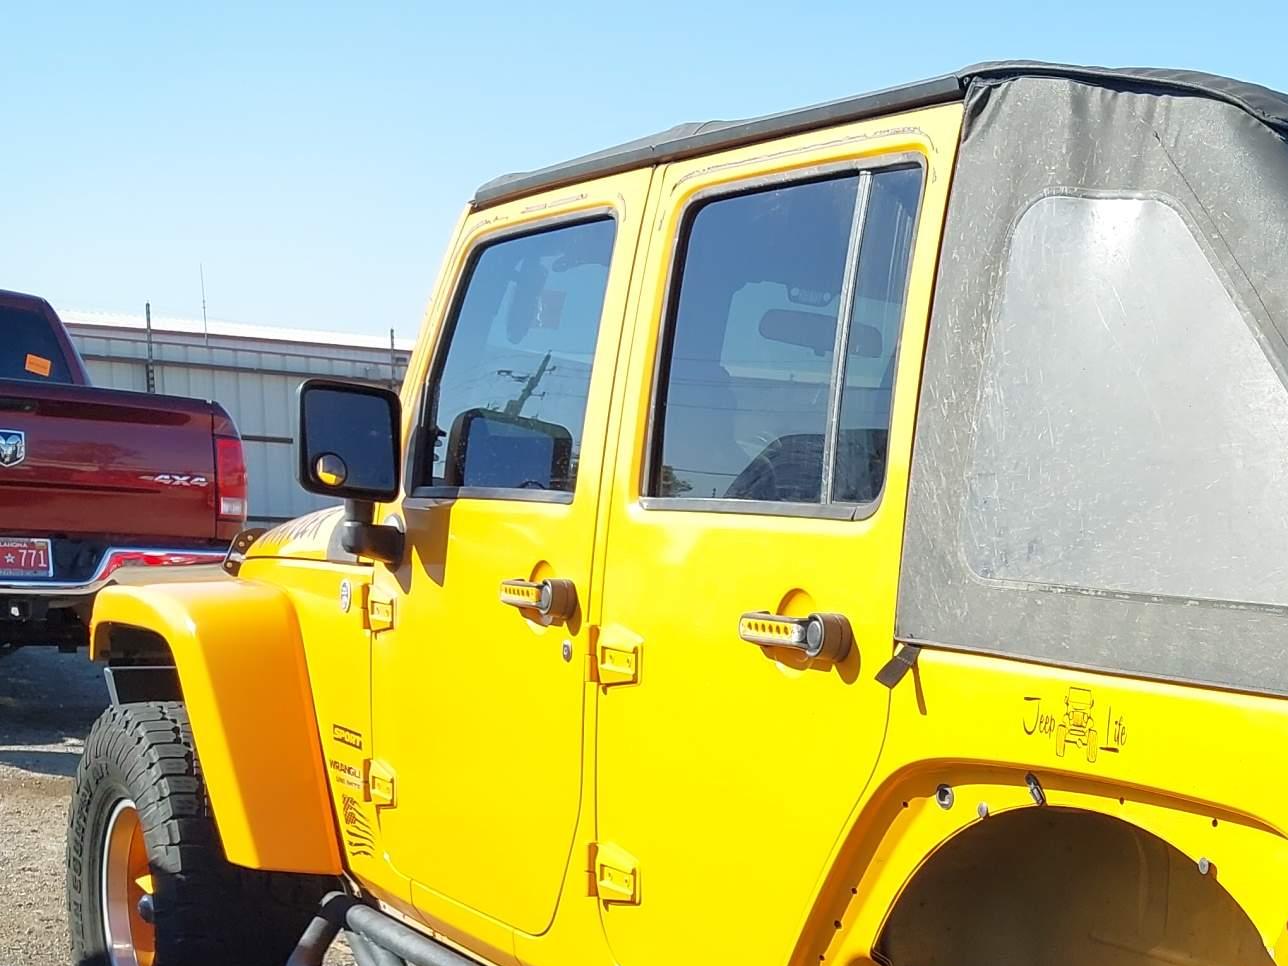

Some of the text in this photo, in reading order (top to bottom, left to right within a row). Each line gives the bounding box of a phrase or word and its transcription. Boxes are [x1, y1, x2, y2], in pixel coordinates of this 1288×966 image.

[18, 549, 48, 568] 771
[333, 724, 363, 750] SPORT
[1022, 696, 1128, 753] Jeep Life
